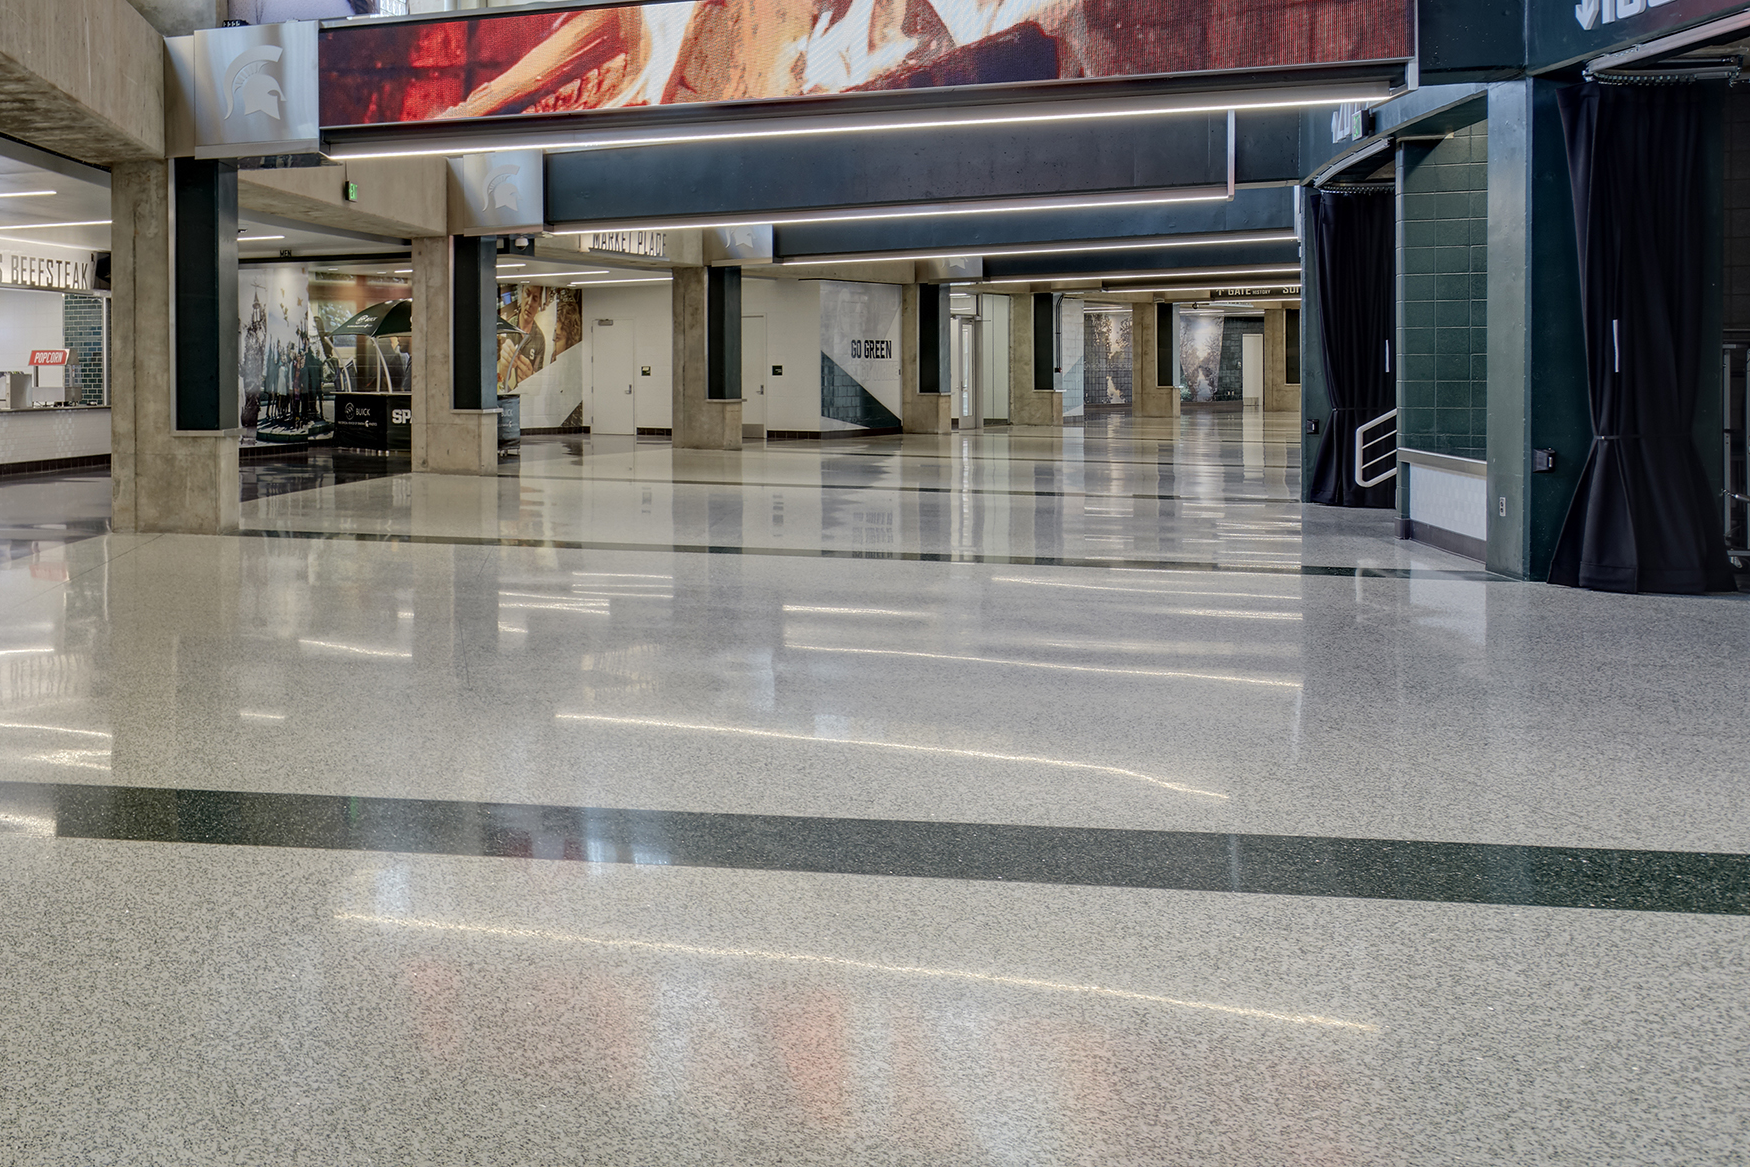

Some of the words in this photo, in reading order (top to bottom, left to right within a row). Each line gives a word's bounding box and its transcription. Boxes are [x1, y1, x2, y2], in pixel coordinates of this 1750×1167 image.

[637, 231, 667, 256] PLACE
[11, 255, 89, 290] BEEFSTEAK
[34, 351, 63, 363] POPCORN
[851, 339, 862, 359] GO
[864, 339, 892, 359] GREEN
[356, 408, 370, 416] BUICK
